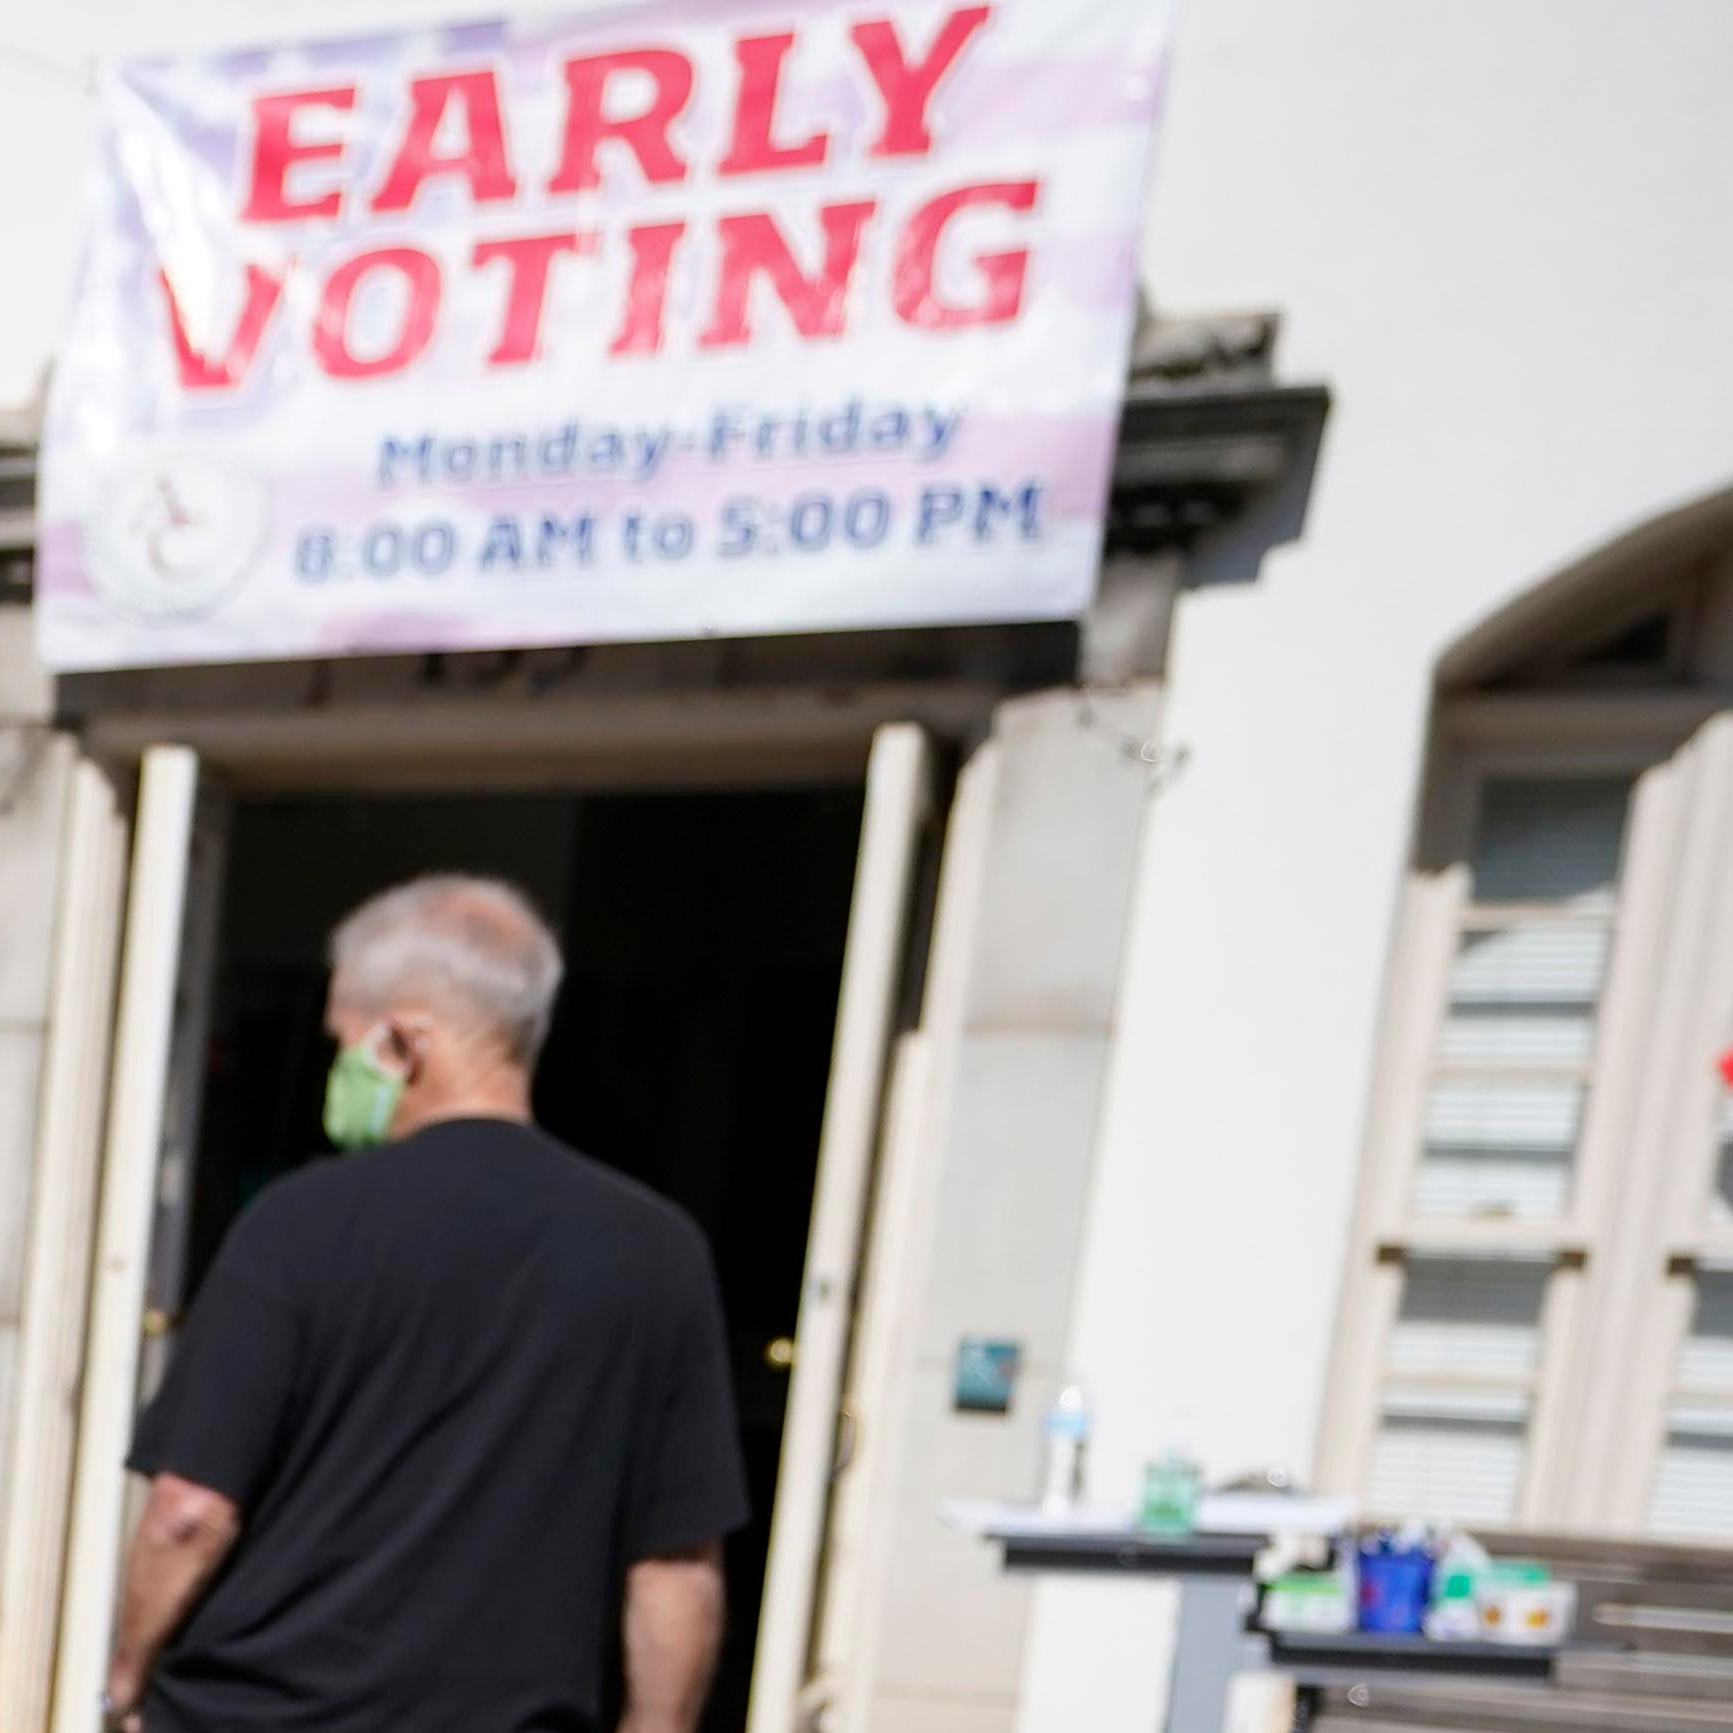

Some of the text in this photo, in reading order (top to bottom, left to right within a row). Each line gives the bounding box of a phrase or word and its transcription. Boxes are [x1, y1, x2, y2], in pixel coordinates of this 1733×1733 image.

[240, 5, 992, 222] EARLY
[156, 180, 1039, 388] VOTING
[374, 396, 967, 490] Monday-Friday
[477, 508, 597, 573] AM
[621, 503, 695, 563] to
[716, 489, 891, 560] 5:00
[914, 479, 1049, 550] PM
